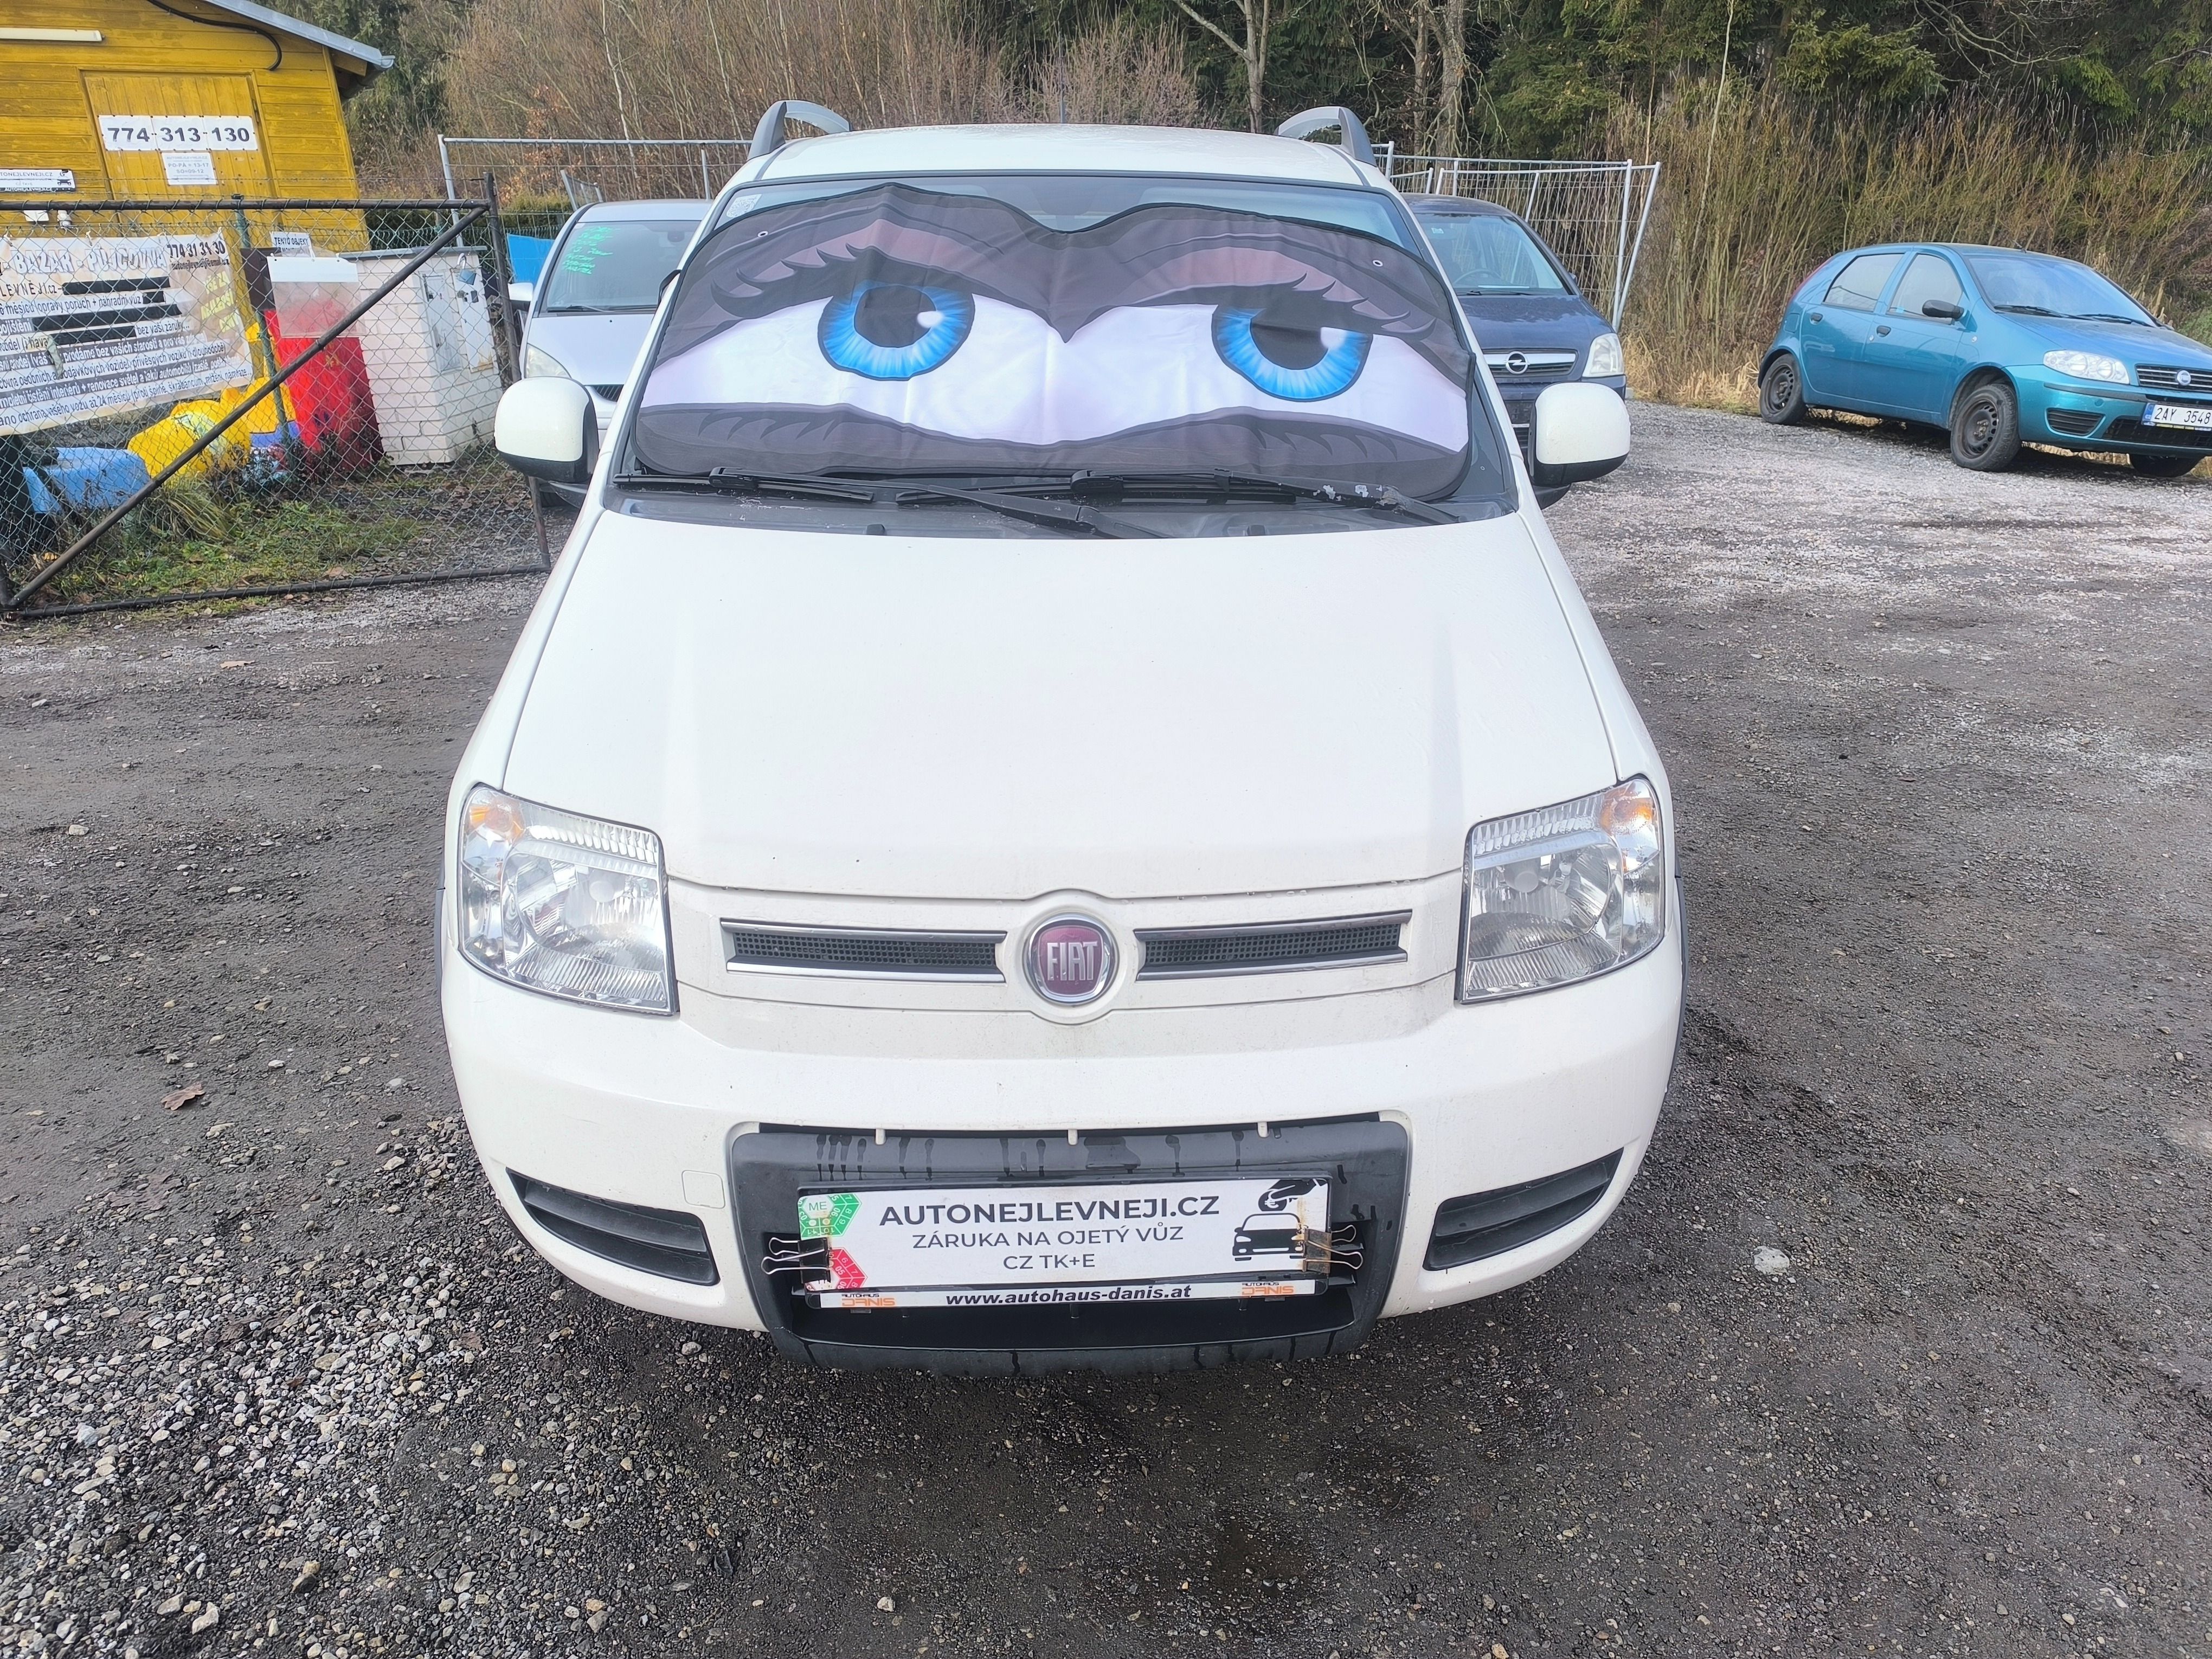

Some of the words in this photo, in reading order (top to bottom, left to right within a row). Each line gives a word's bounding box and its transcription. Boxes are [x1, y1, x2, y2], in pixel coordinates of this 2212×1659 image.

[107, 127, 249, 142] 774-313-130
[11, 249, 75, 274] BAZAR
[137, 325, 149, 335] bez
[95, 345, 110, 357] bez
[2155, 407, 2177, 421] 2AY
[2184, 410, 2211, 425] 3548
[1047, 941, 1098, 981] FIAT
[808, 1201, 828, 1211] ME
[879, 1196, 1219, 1226] AUTONEJLEVNEJI.CZ
[912, 1231, 1010, 1249] ZÁRUKA
[1018, 1232, 1051, 1246] NA
[1057, 1225, 1130, 1245] OJETÝ
[1136, 1221, 1184, 1242] VŮZ
[1004, 1256, 1033, 1270] CZ
[1039, 1253, 1096, 1269] TK+E
[947, 1285, 1192, 1304] www.autohaus-danis.at
[1242, 1285, 1295, 1296] DANIS
[841, 1297, 896, 1307] DANIS
